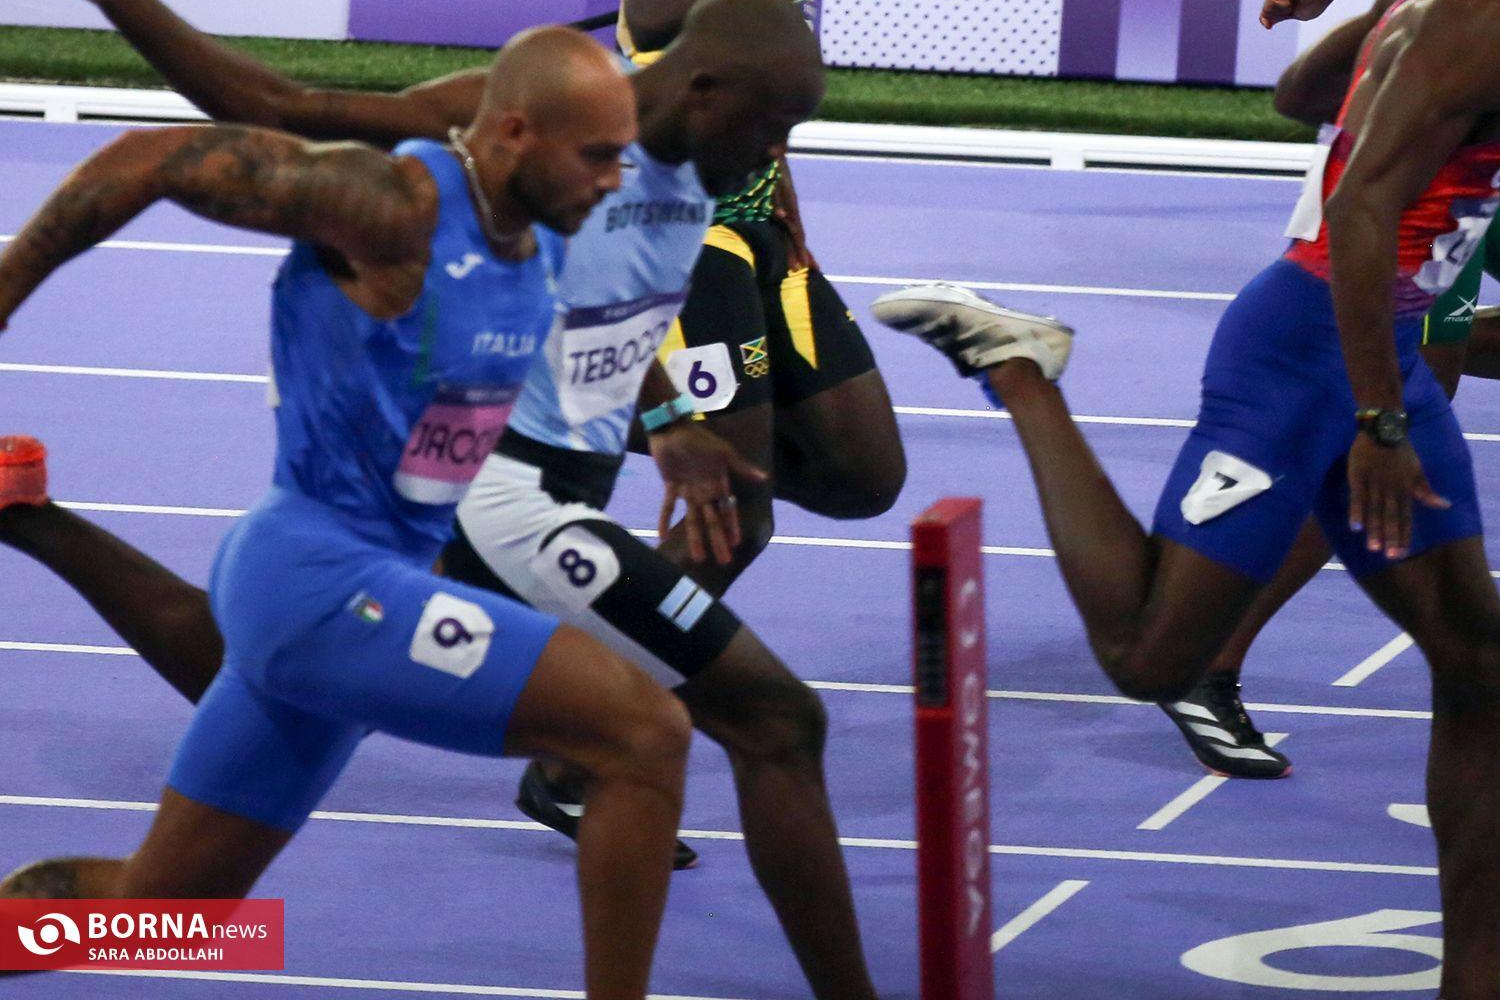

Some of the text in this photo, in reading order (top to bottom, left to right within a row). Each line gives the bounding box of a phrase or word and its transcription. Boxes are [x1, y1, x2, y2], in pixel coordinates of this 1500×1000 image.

[471, 331, 537, 357] ITALIA
[688, 360, 717, 399] 6
[558, 548, 598, 589] 8
[433, 617, 473, 649] 9
